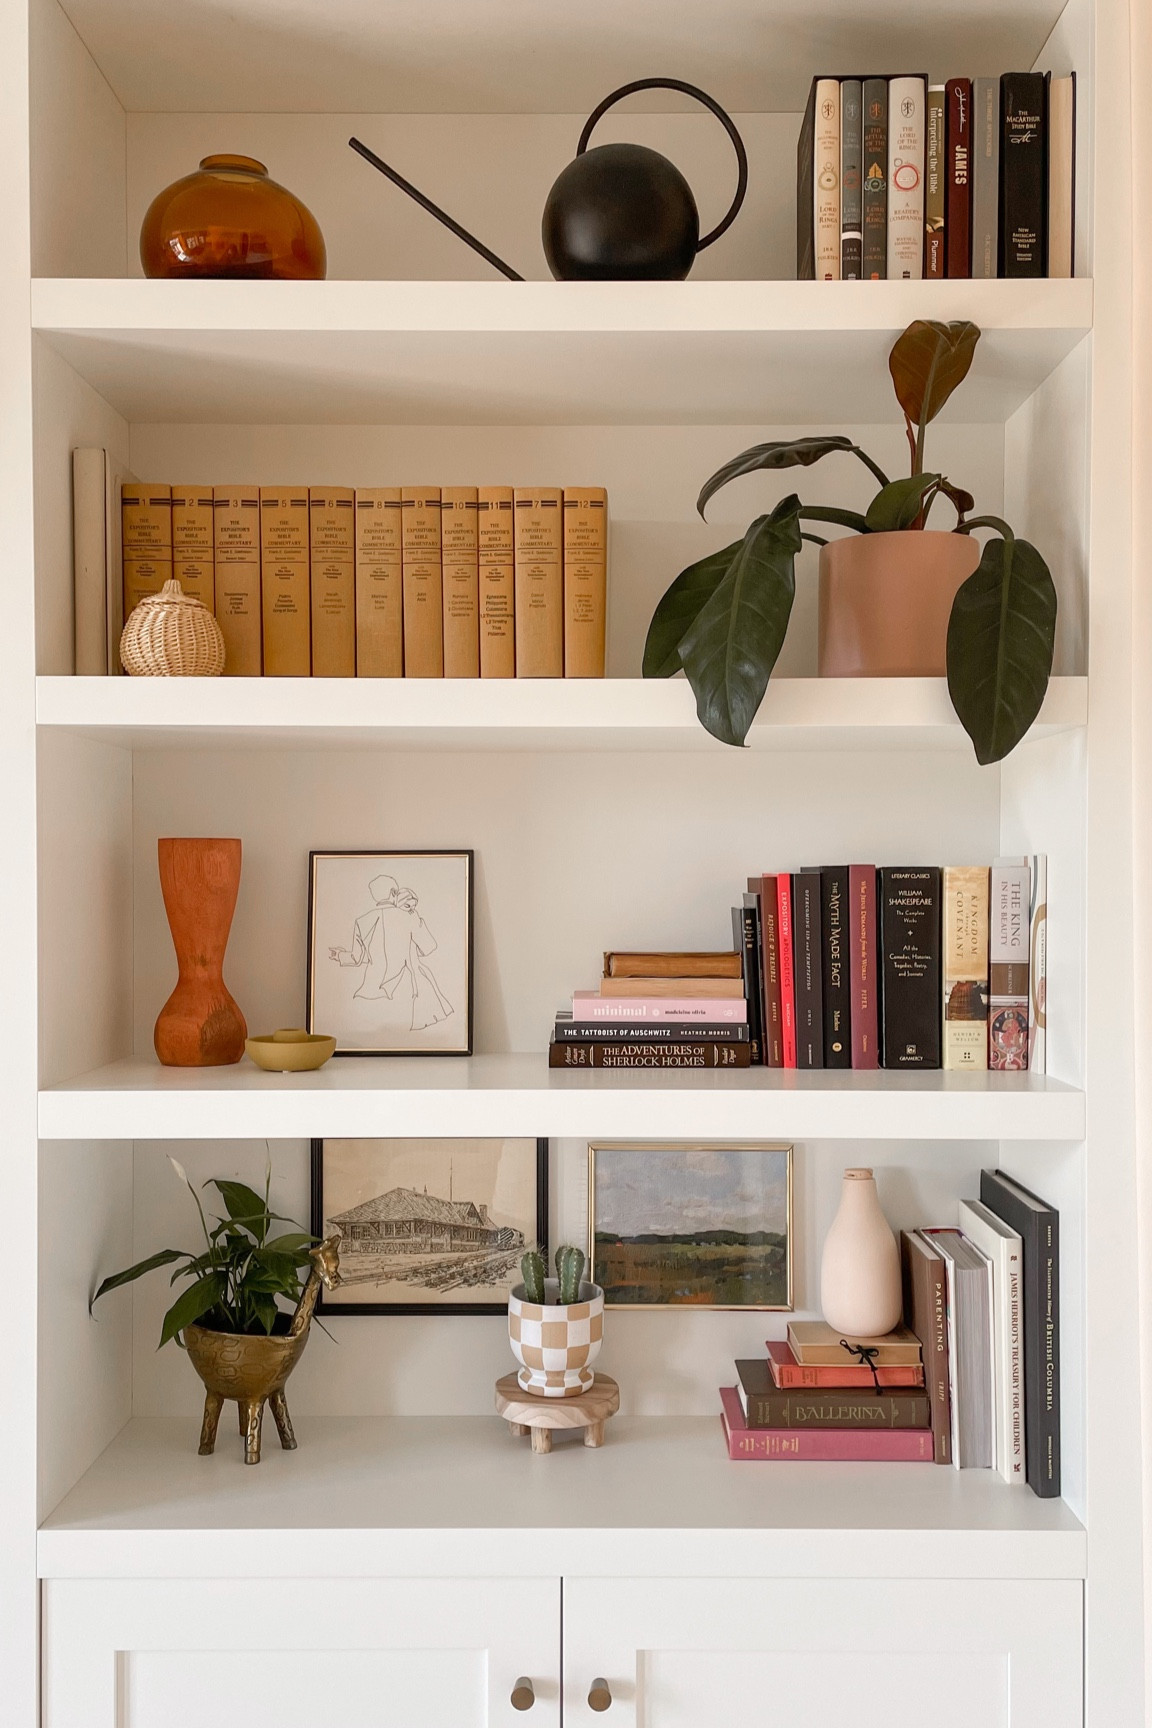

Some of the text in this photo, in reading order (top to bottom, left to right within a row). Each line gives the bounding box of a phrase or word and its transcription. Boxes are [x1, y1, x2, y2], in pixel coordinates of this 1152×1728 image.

[928, 107, 938, 194] Interpreting the Bible
[955, 145, 967, 184] JAMES
[377, 501, 382, 509] 8
[1001, 881, 1008, 891] IN
[829, 894, 841, 928] MYTH
[1011, 881, 1020, 947] THE KING
[830, 928, 841, 960] MADE
[832, 962, 841, 988] FACT
[593, 1005, 646, 1016] minimal
[578, 1049, 586, 1063] Doyle
[603, 1057, 705, 1066] SHERLOCK HOLMES
[620, 1045, 692, 1055] ADVENTURES
[1010, 1273, 1018, 1298] JAMES
[935, 1283, 944, 1351] PARENTING
[795, 1406, 886, 1421] BALLERINA
